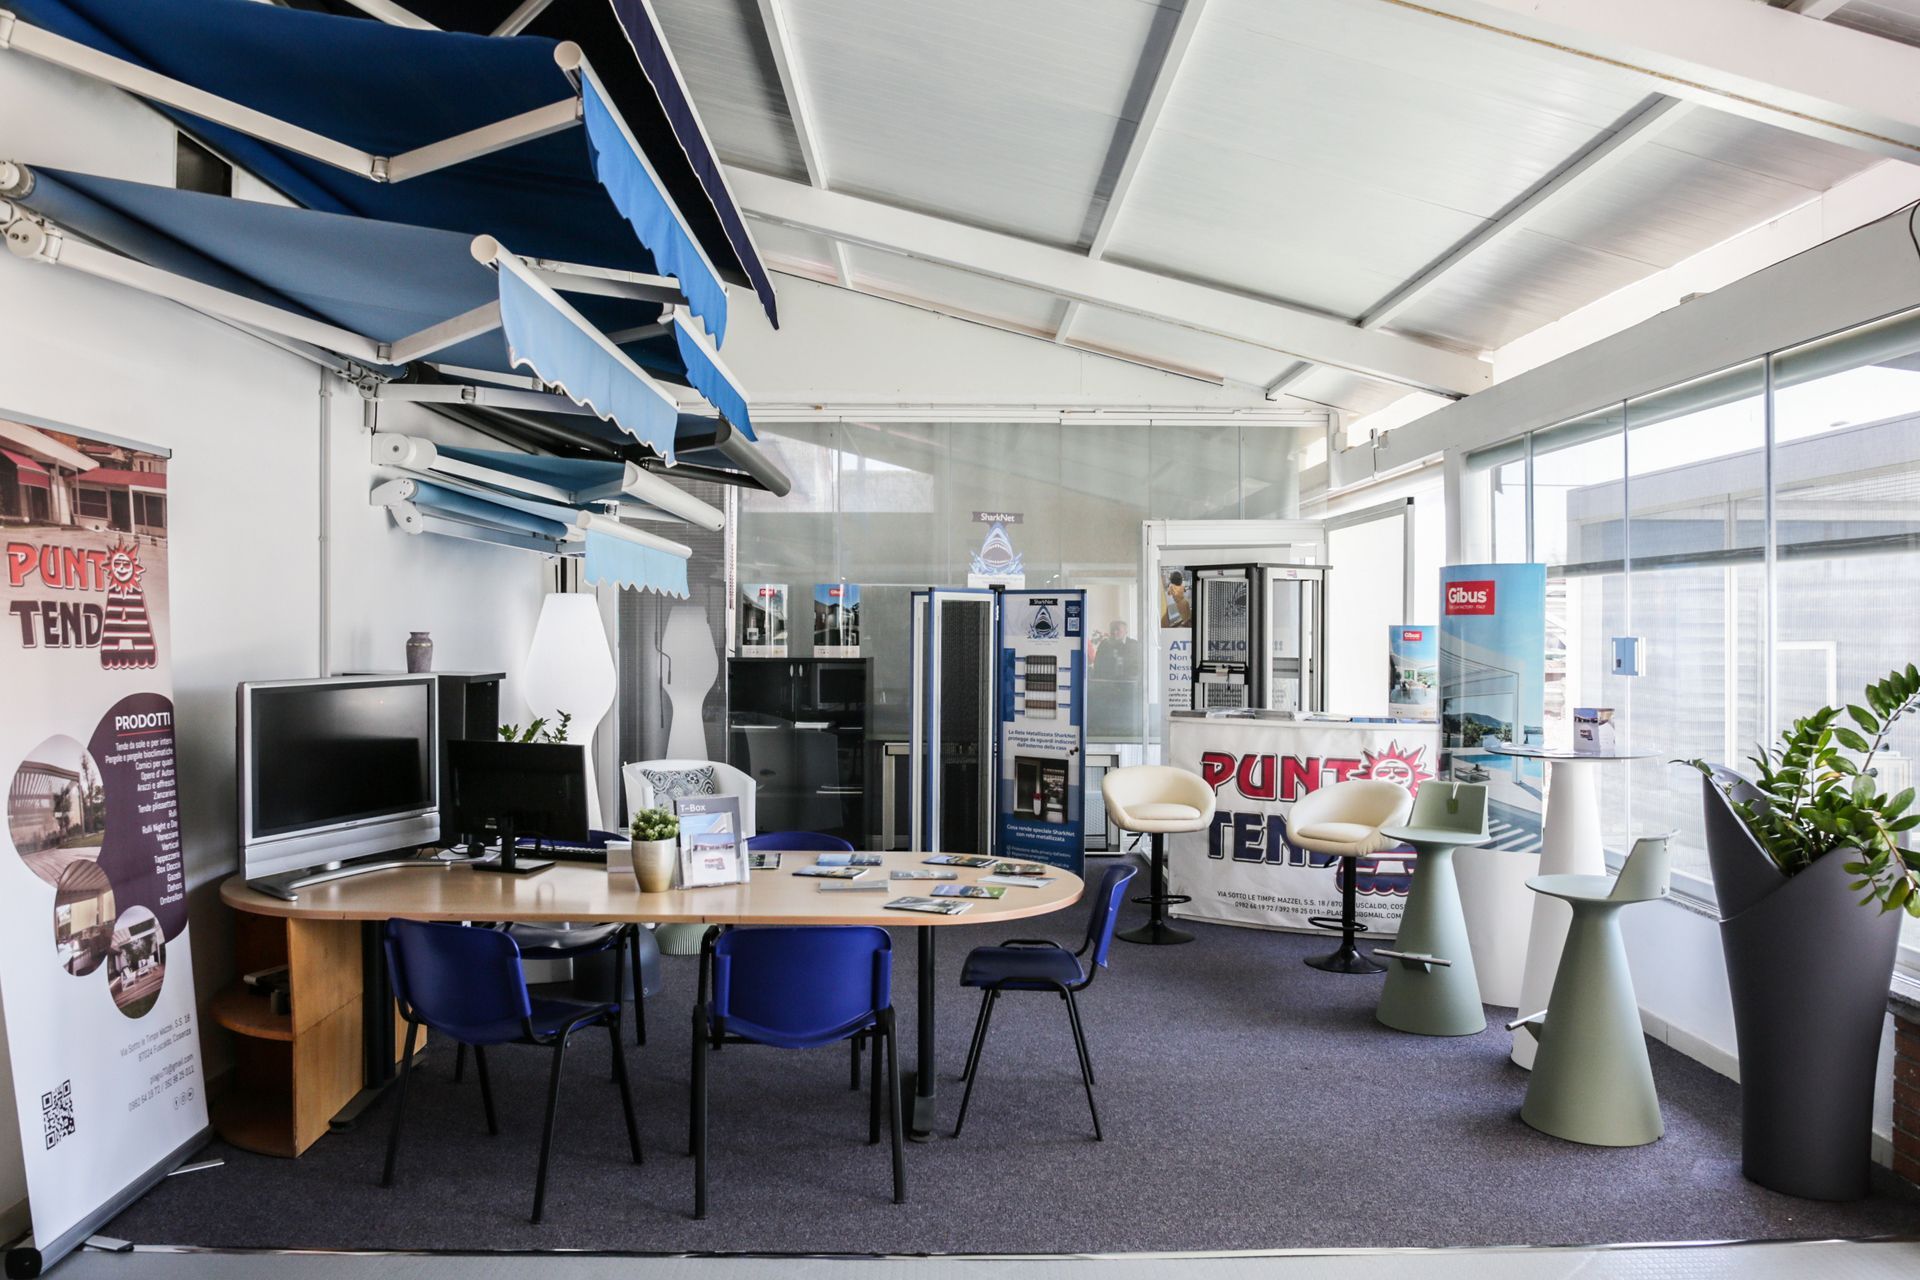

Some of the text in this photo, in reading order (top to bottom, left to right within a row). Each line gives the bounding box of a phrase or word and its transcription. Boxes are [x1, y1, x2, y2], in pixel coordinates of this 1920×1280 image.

[980, 512, 1015, 522] SharkNet
[1448, 587, 1487, 604] Gibus
[1169, 653, 1187, 661] Non
[1169, 673, 1179, 681] Di
[115, 712, 171, 731] PRODOTTI
[680, 804, 706, 812] T-Box
[1227, 892, 1247, 900] SOTTO
